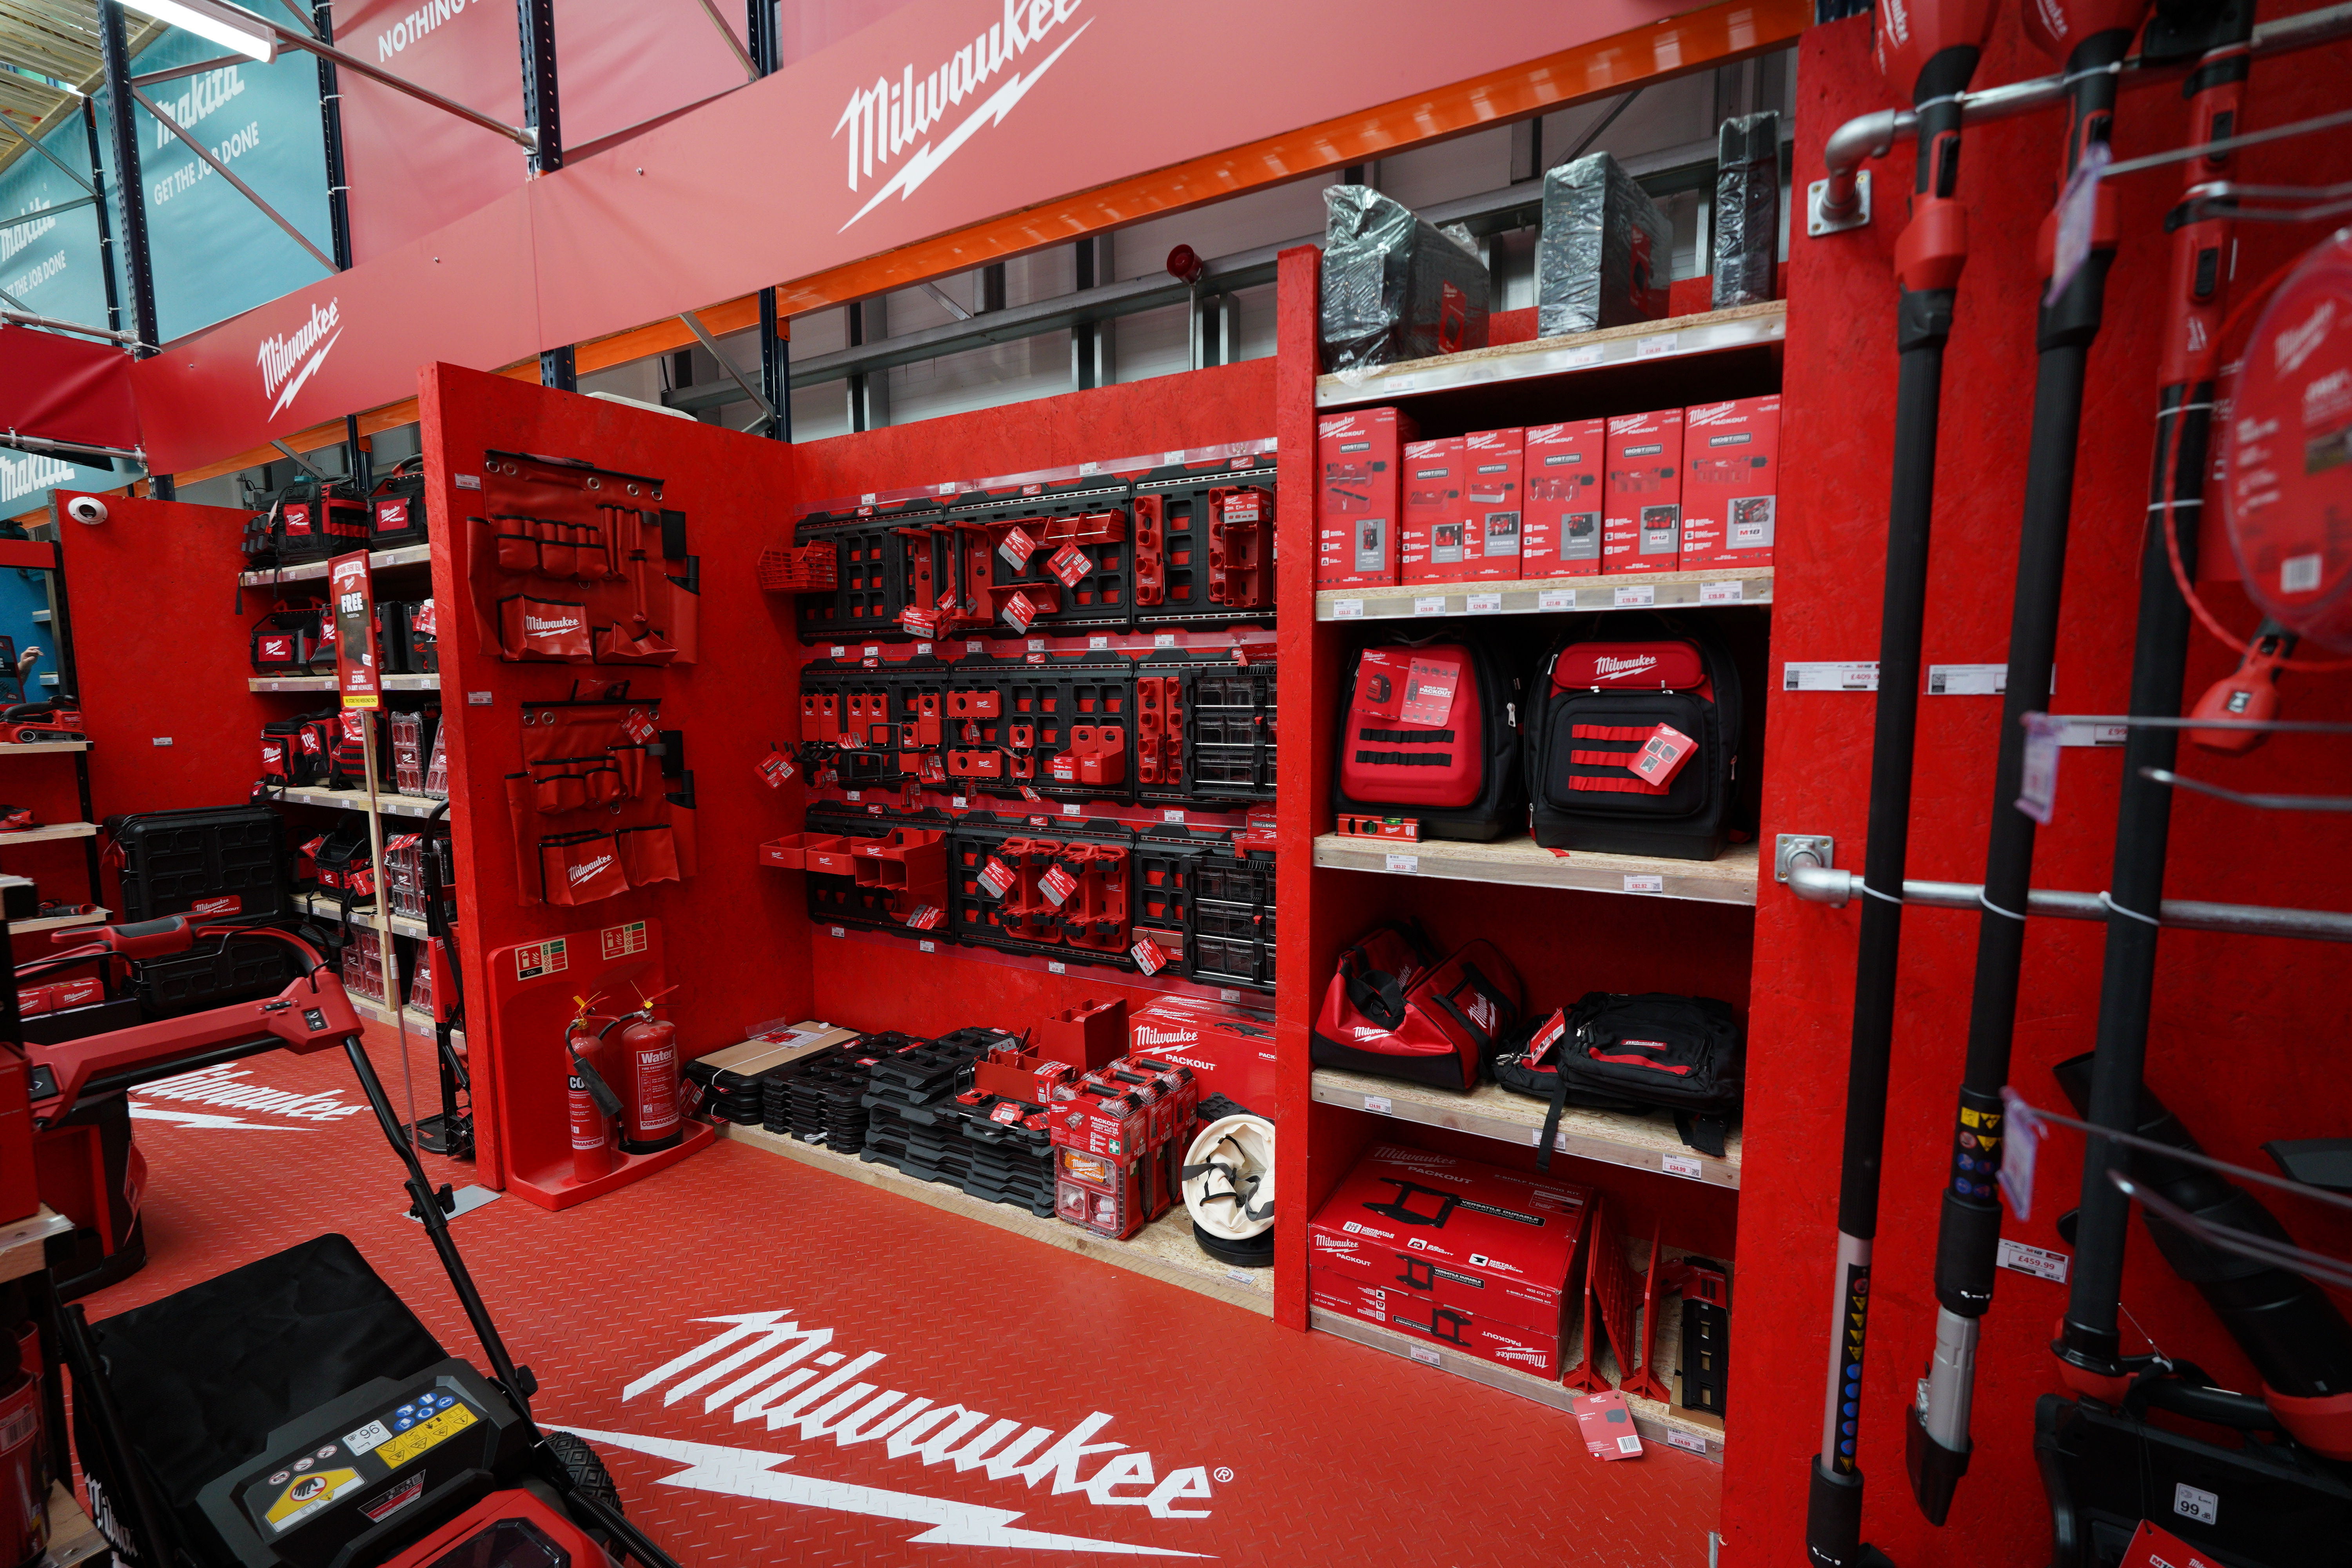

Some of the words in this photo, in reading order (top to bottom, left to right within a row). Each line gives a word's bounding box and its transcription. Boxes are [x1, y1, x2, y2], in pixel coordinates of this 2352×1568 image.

[154, 175, 174, 205] GET
[175, 163, 195, 195] THE
[222, 121, 260, 164] DONE
[14, 276, 28, 298] THE
[29, 265, 42, 290] JOB
[43, 250, 66, 278] DONE
[257, 301, 339, 400] Milwaukee
[1688, 402, 1735, 423] Milwaukee
[1319, 416, 1355, 435] Milwaukee
[1609, 414, 1648, 432] Milwaukee
[1711, 416, 1748, 426] PACKOUT
[1527, 425, 1564, 441] Milwaukee
[1628, 426, 1659, 435] PACKOUT
[1467, 433, 1497, 446] Milwaukee
[1710, 436, 1733, 445] MOST
[1405, 441, 1436, 456] Milwaukee
[341, 592, 364, 613] FREE
[526, 615, 580, 631] Milwaukee
[1594, 654, 1657, 674] Milwaukee
[1419, 688, 1452, 696] PACKOUT
[568, 854, 613, 882] Milwaukee
[64, 988, 93, 1002] Milwaukee
[1161, 995, 1209, 1004] Milwaukee
[1146, 1008, 1194, 1017] Milwaukee
[1178, 1002, 1212, 1011] PACKOUT
[1163, 1015, 1197, 1024] PACKOUT
[1133, 1025, 1198, 1045] Milwaukee
[641, 1049, 673, 1064] Water
[1165, 1054, 1216, 1071] PACKOUT
[128, 1063, 365, 1121] Milwaukee
[642, 1113, 678, 1127] COMMANDER
[1090, 1116, 1120, 1128] PACKOUT
[1091, 1121, 1118, 1132] WORKPLACE
[1373, 1145, 1457, 1164] Milwaukee
[1072, 1158, 1098, 1168] Milwaukee
[1084, 1171, 1104, 1180] PACKOUT
[1408, 1166, 1472, 1183] PACKOUT
[1494, 1174, 1527, 1183] 2-SHELF
[1528, 1182, 1564, 1192] RACKING
[1460, 1203, 1488, 1212] MODULAR
[1488, 1209, 1515, 1219] STORAGE
[1462, 1200, 1501, 1212] VERSATILE
[1503, 1210, 1539, 1221] DURABLE
[1363, 1226, 1395, 1236] VERSATILE
[1314, 1234, 1359, 1248] Milwaukee
[1426, 1247, 1454, 1256] CAPACITY
[1336, 1253, 1371, 1267] PACKOUT
[1488, 1262, 1523, 1273] REINFORCED
[2018, 1256, 2054, 1270] £459.99
[1435, 1269, 1459, 1278] VERSATILE
[1459, 1275, 1482, 1284] DURABLE
[1506, 1289, 1524, 1298] 2-SHELF
[1482, 1331, 1521, 1347] PACKOUT
[1495, 1351, 1549, 1368] Milwaukee
[622, 1310, 1212, 1518] Milwaukee
[360, 1425, 380, 1439] 96
[2181, 1501, 2199, 1515] 99
